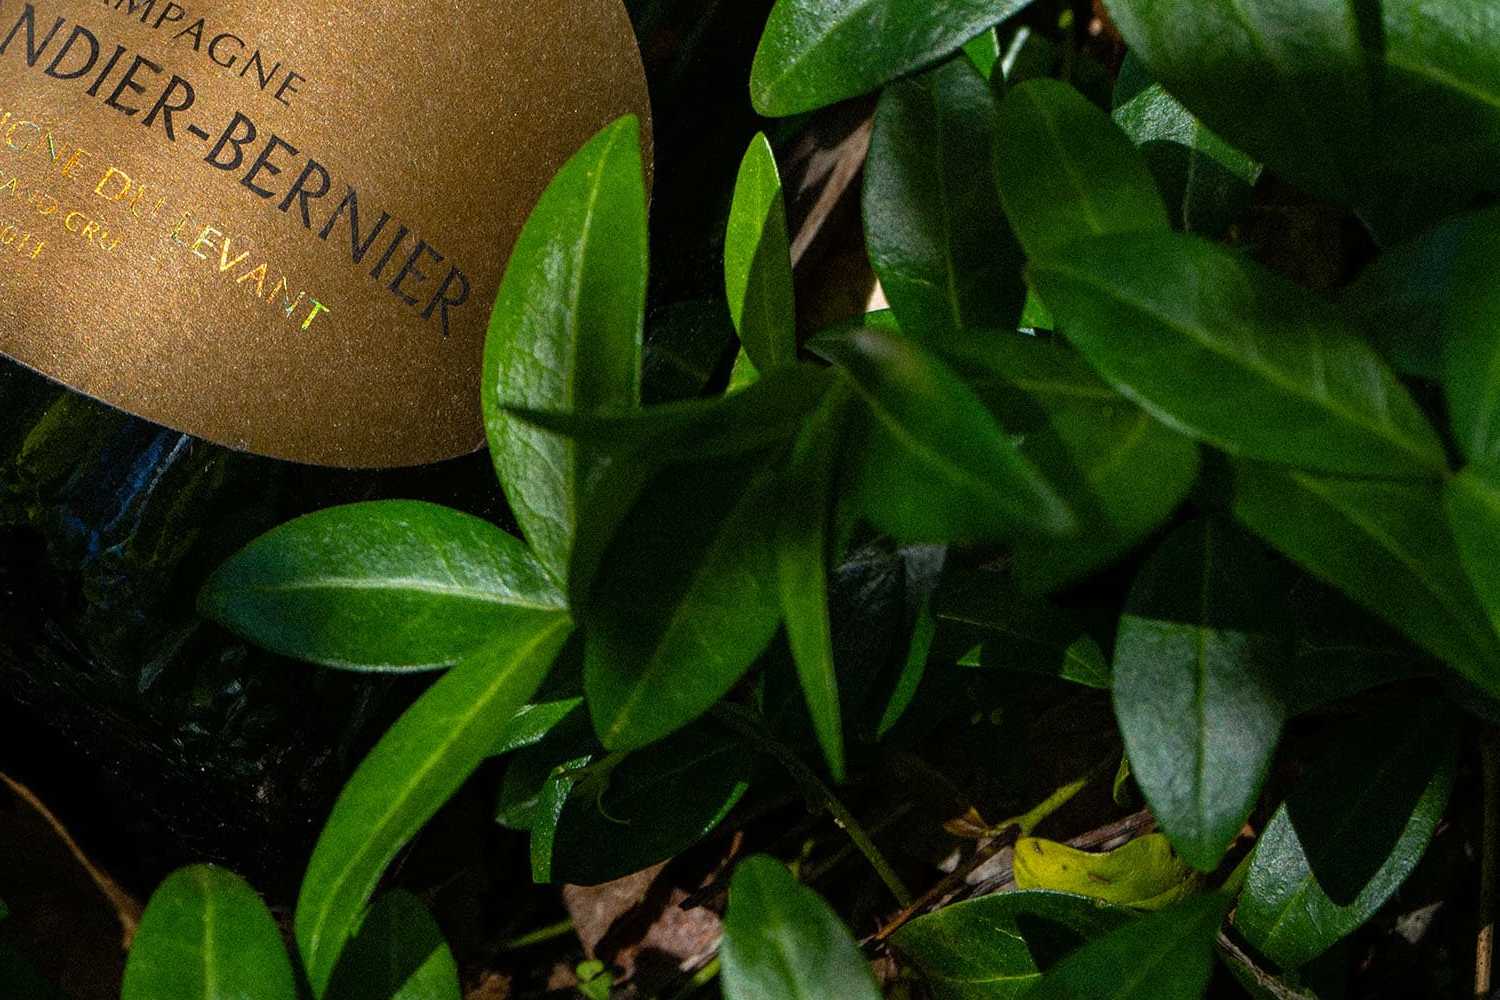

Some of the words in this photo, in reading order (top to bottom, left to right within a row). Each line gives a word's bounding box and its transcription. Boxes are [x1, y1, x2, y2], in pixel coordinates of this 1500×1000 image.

[64, 210, 121, 252] CRU
[94, 166, 165, 223] DU
[169, 211, 330, 330] LEVANT
